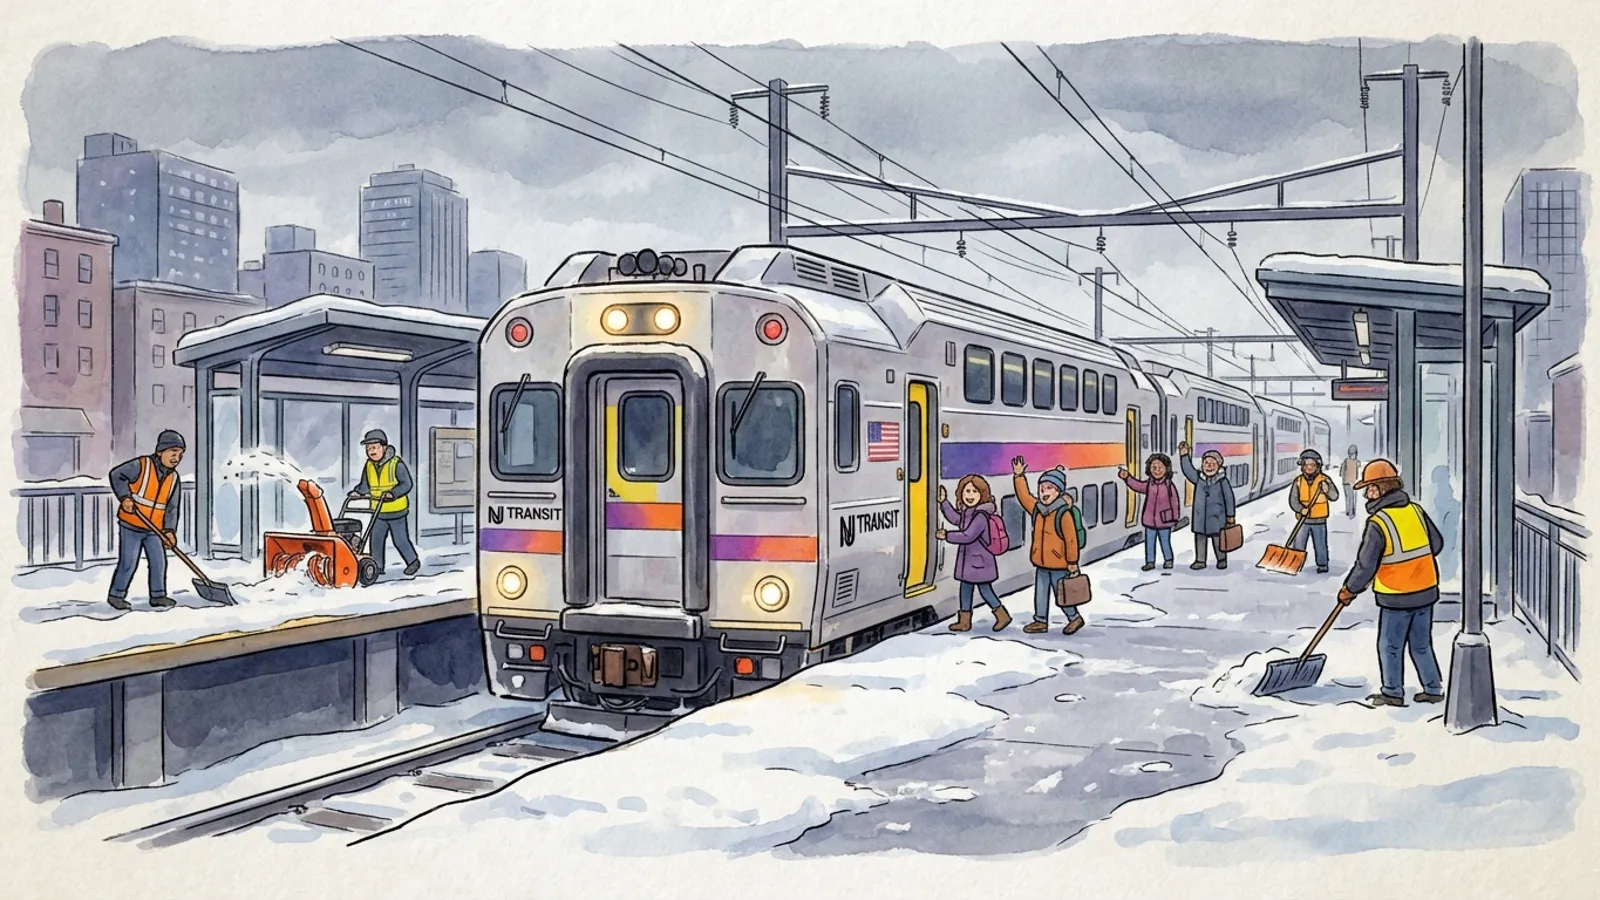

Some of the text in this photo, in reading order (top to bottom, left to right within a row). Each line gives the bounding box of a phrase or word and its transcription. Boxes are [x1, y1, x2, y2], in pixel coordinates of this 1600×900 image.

[488, 505, 562, 525] NJ TRANSIT
[840, 509, 900, 548] NJ TRANSIT
